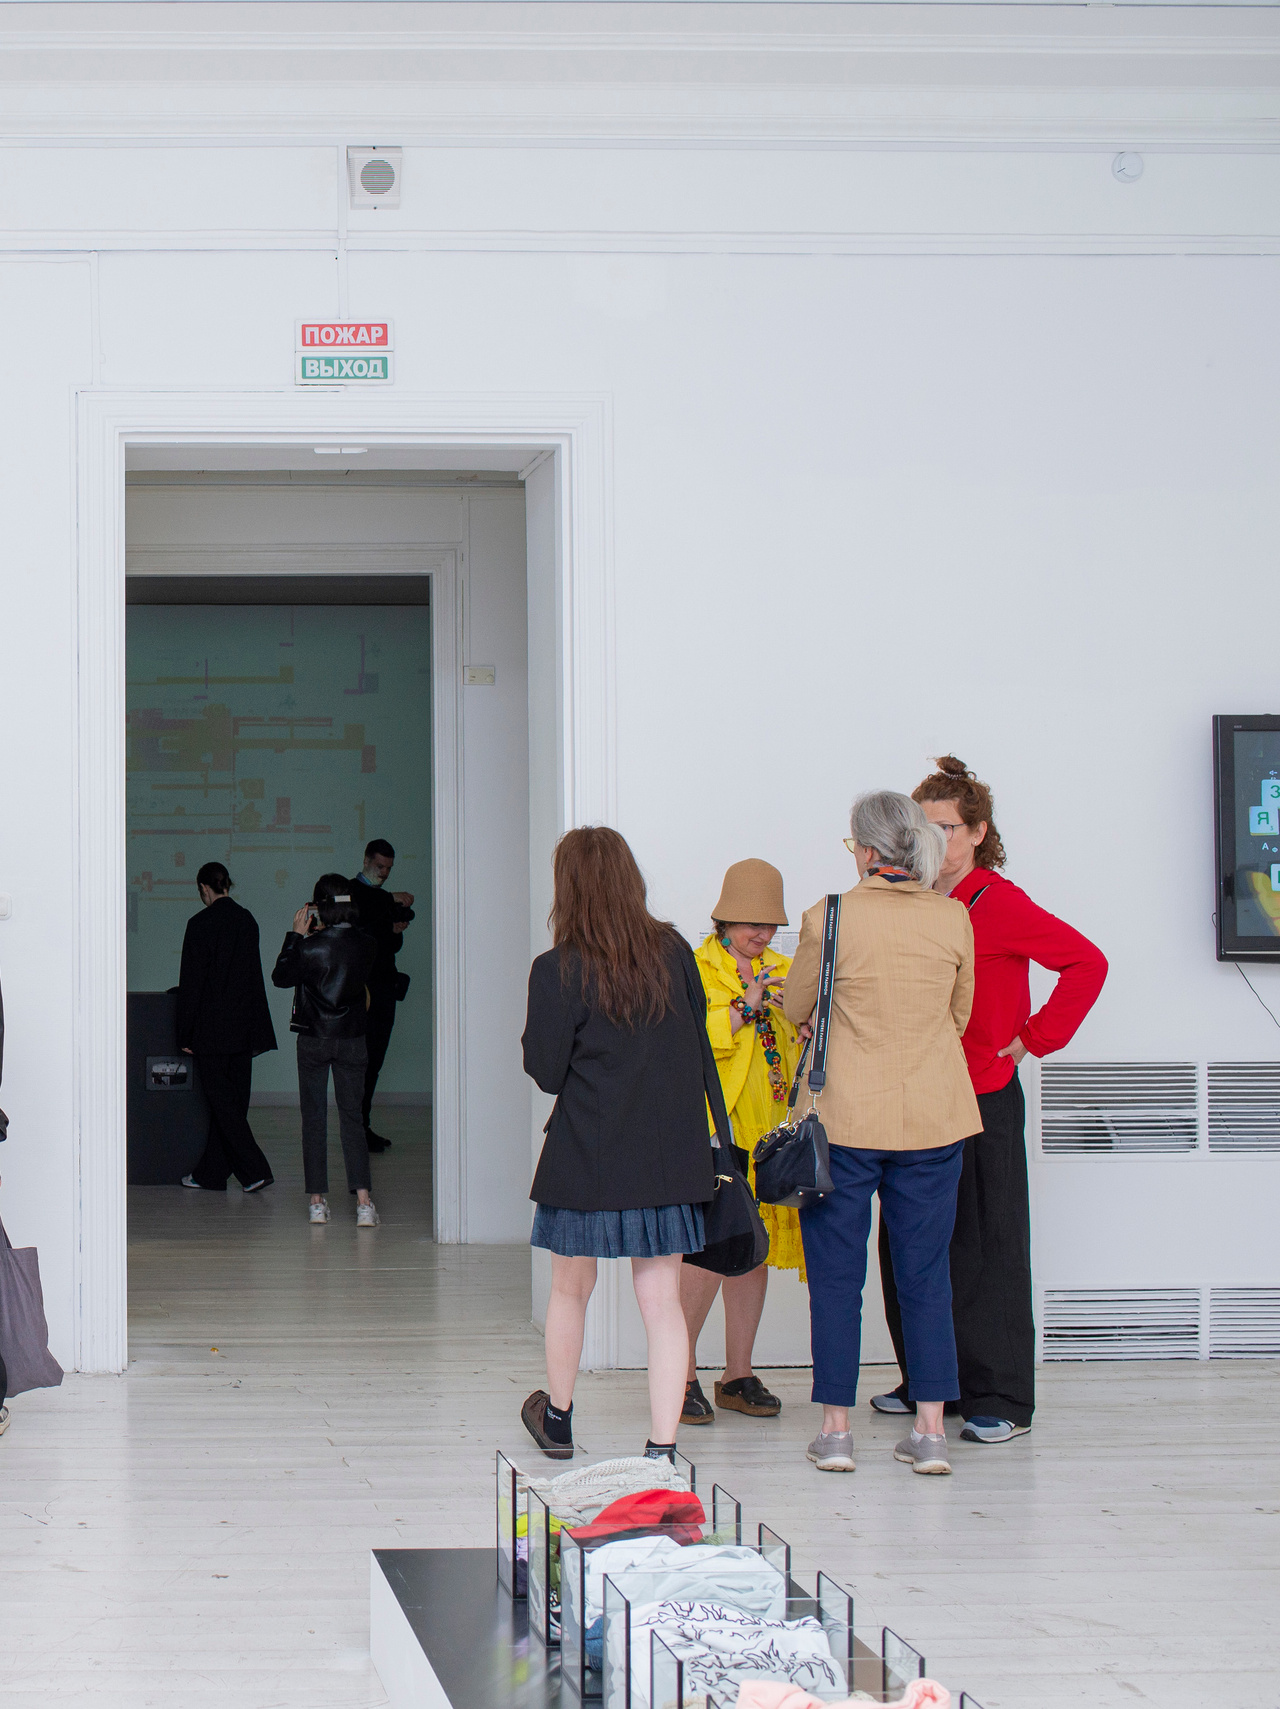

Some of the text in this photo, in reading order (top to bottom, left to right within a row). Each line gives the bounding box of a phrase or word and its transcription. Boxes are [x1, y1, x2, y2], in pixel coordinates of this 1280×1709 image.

[305, 326, 384, 344] ПОЖАР
[305, 359, 384, 378] ВЫХОД
[1257, 811, 1269, 825] Я
